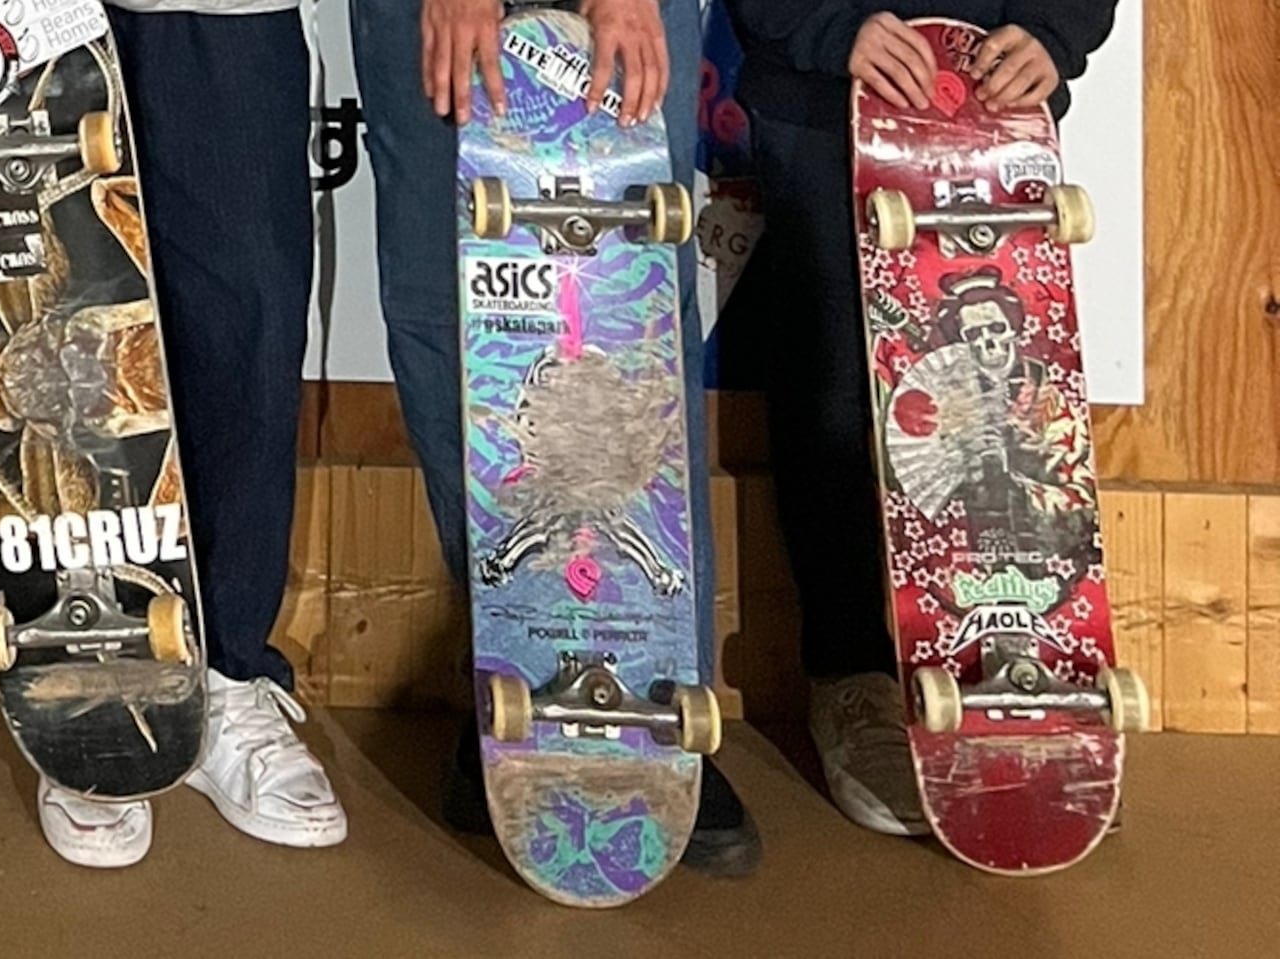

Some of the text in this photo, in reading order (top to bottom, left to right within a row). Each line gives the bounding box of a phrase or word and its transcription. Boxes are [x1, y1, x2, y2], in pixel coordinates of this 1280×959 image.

[40, 0, 95, 34] Beans
[47, 17, 100, 49] Home
[470, 260, 553, 300] asics
